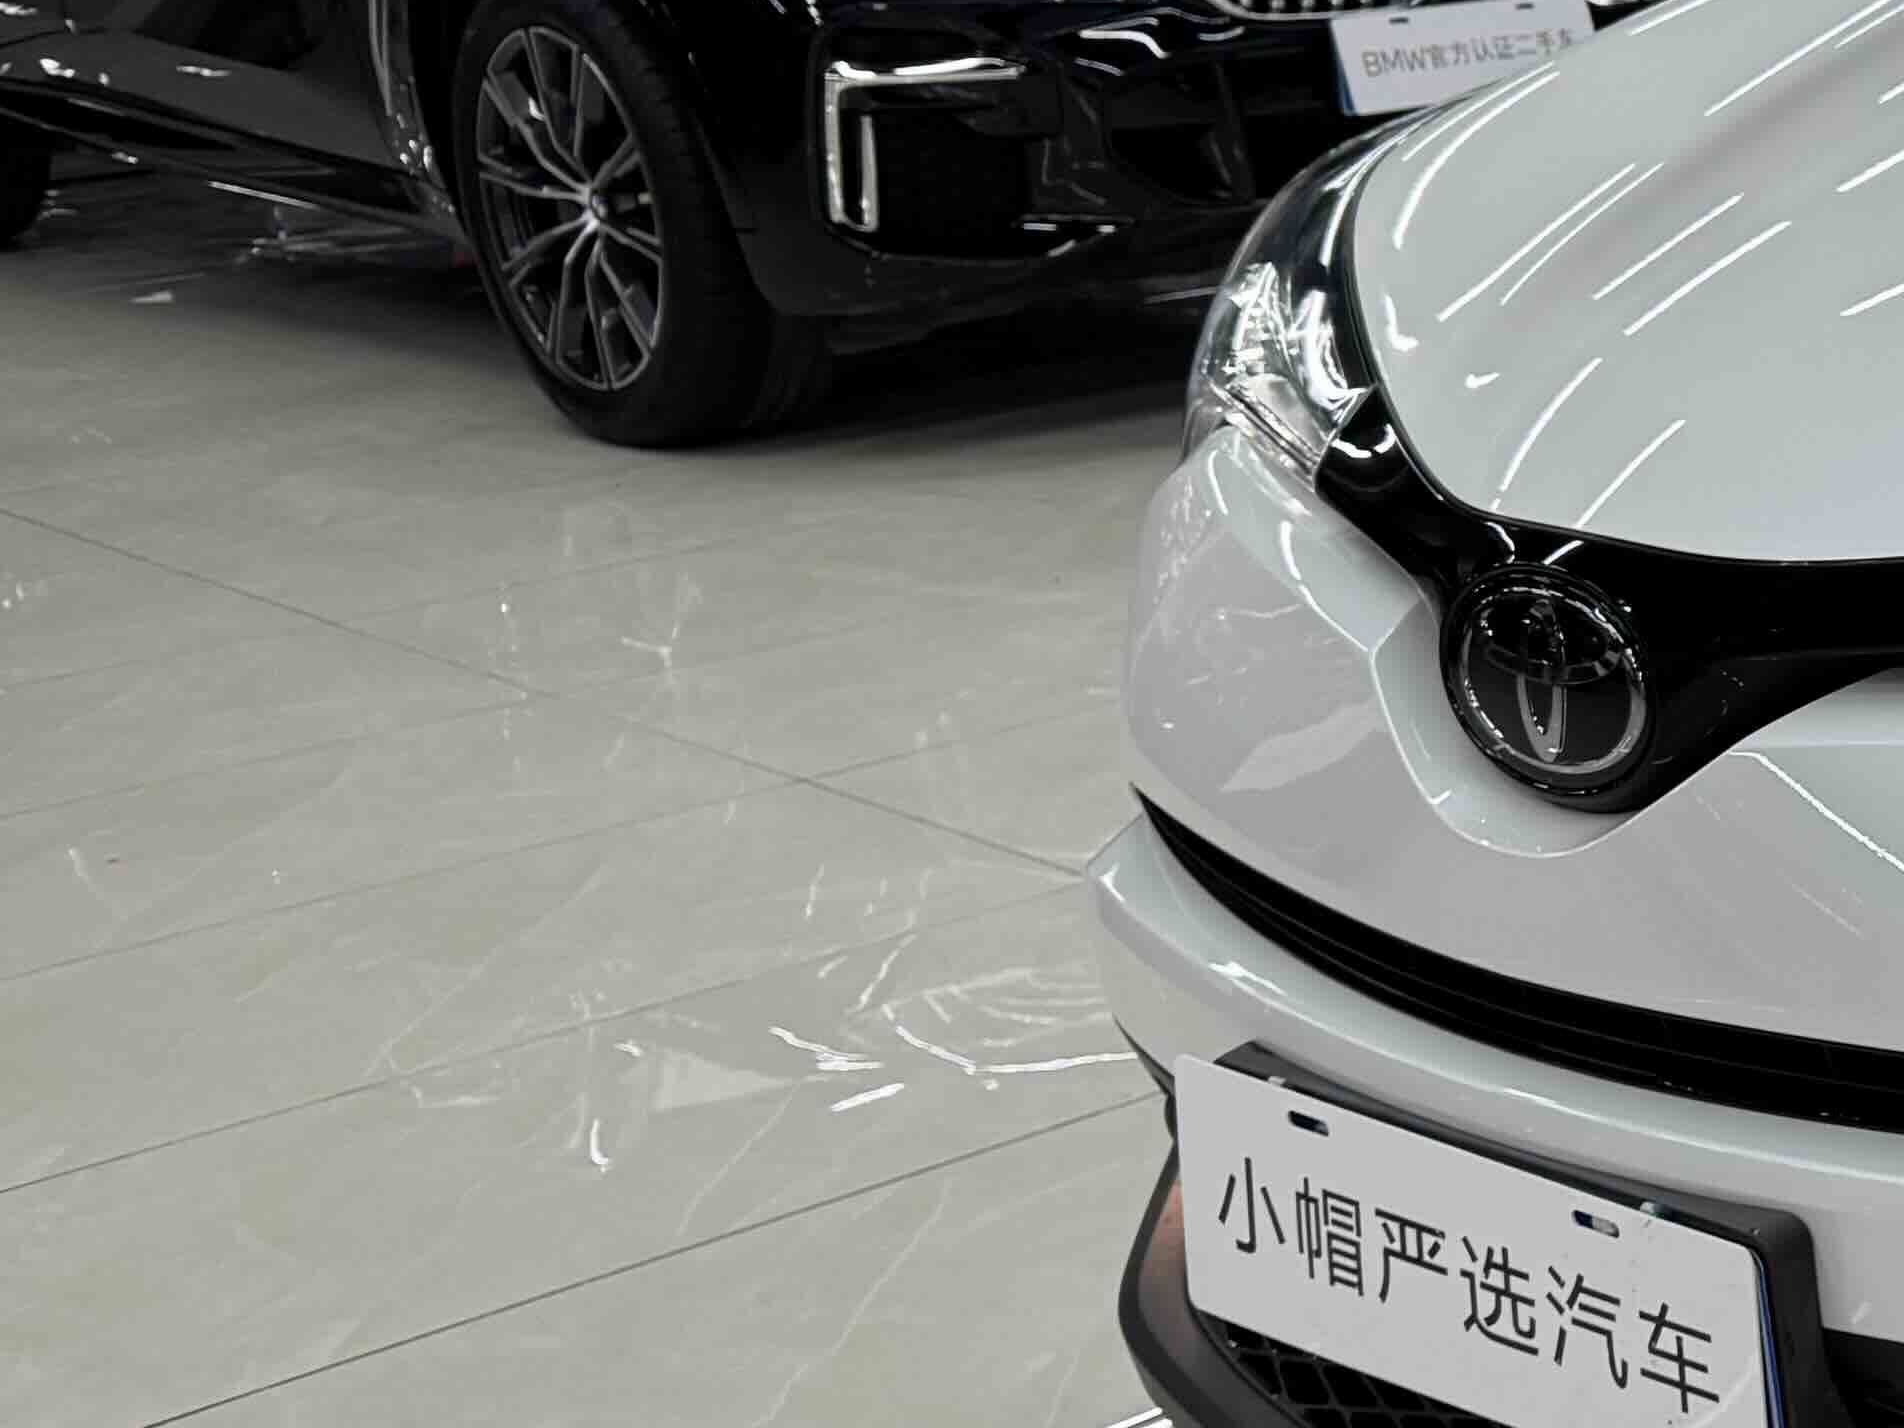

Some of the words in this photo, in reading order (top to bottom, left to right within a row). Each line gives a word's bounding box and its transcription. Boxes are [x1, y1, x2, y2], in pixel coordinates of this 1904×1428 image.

[1218, 1157, 1720, 1413] 小帽严选汽车
